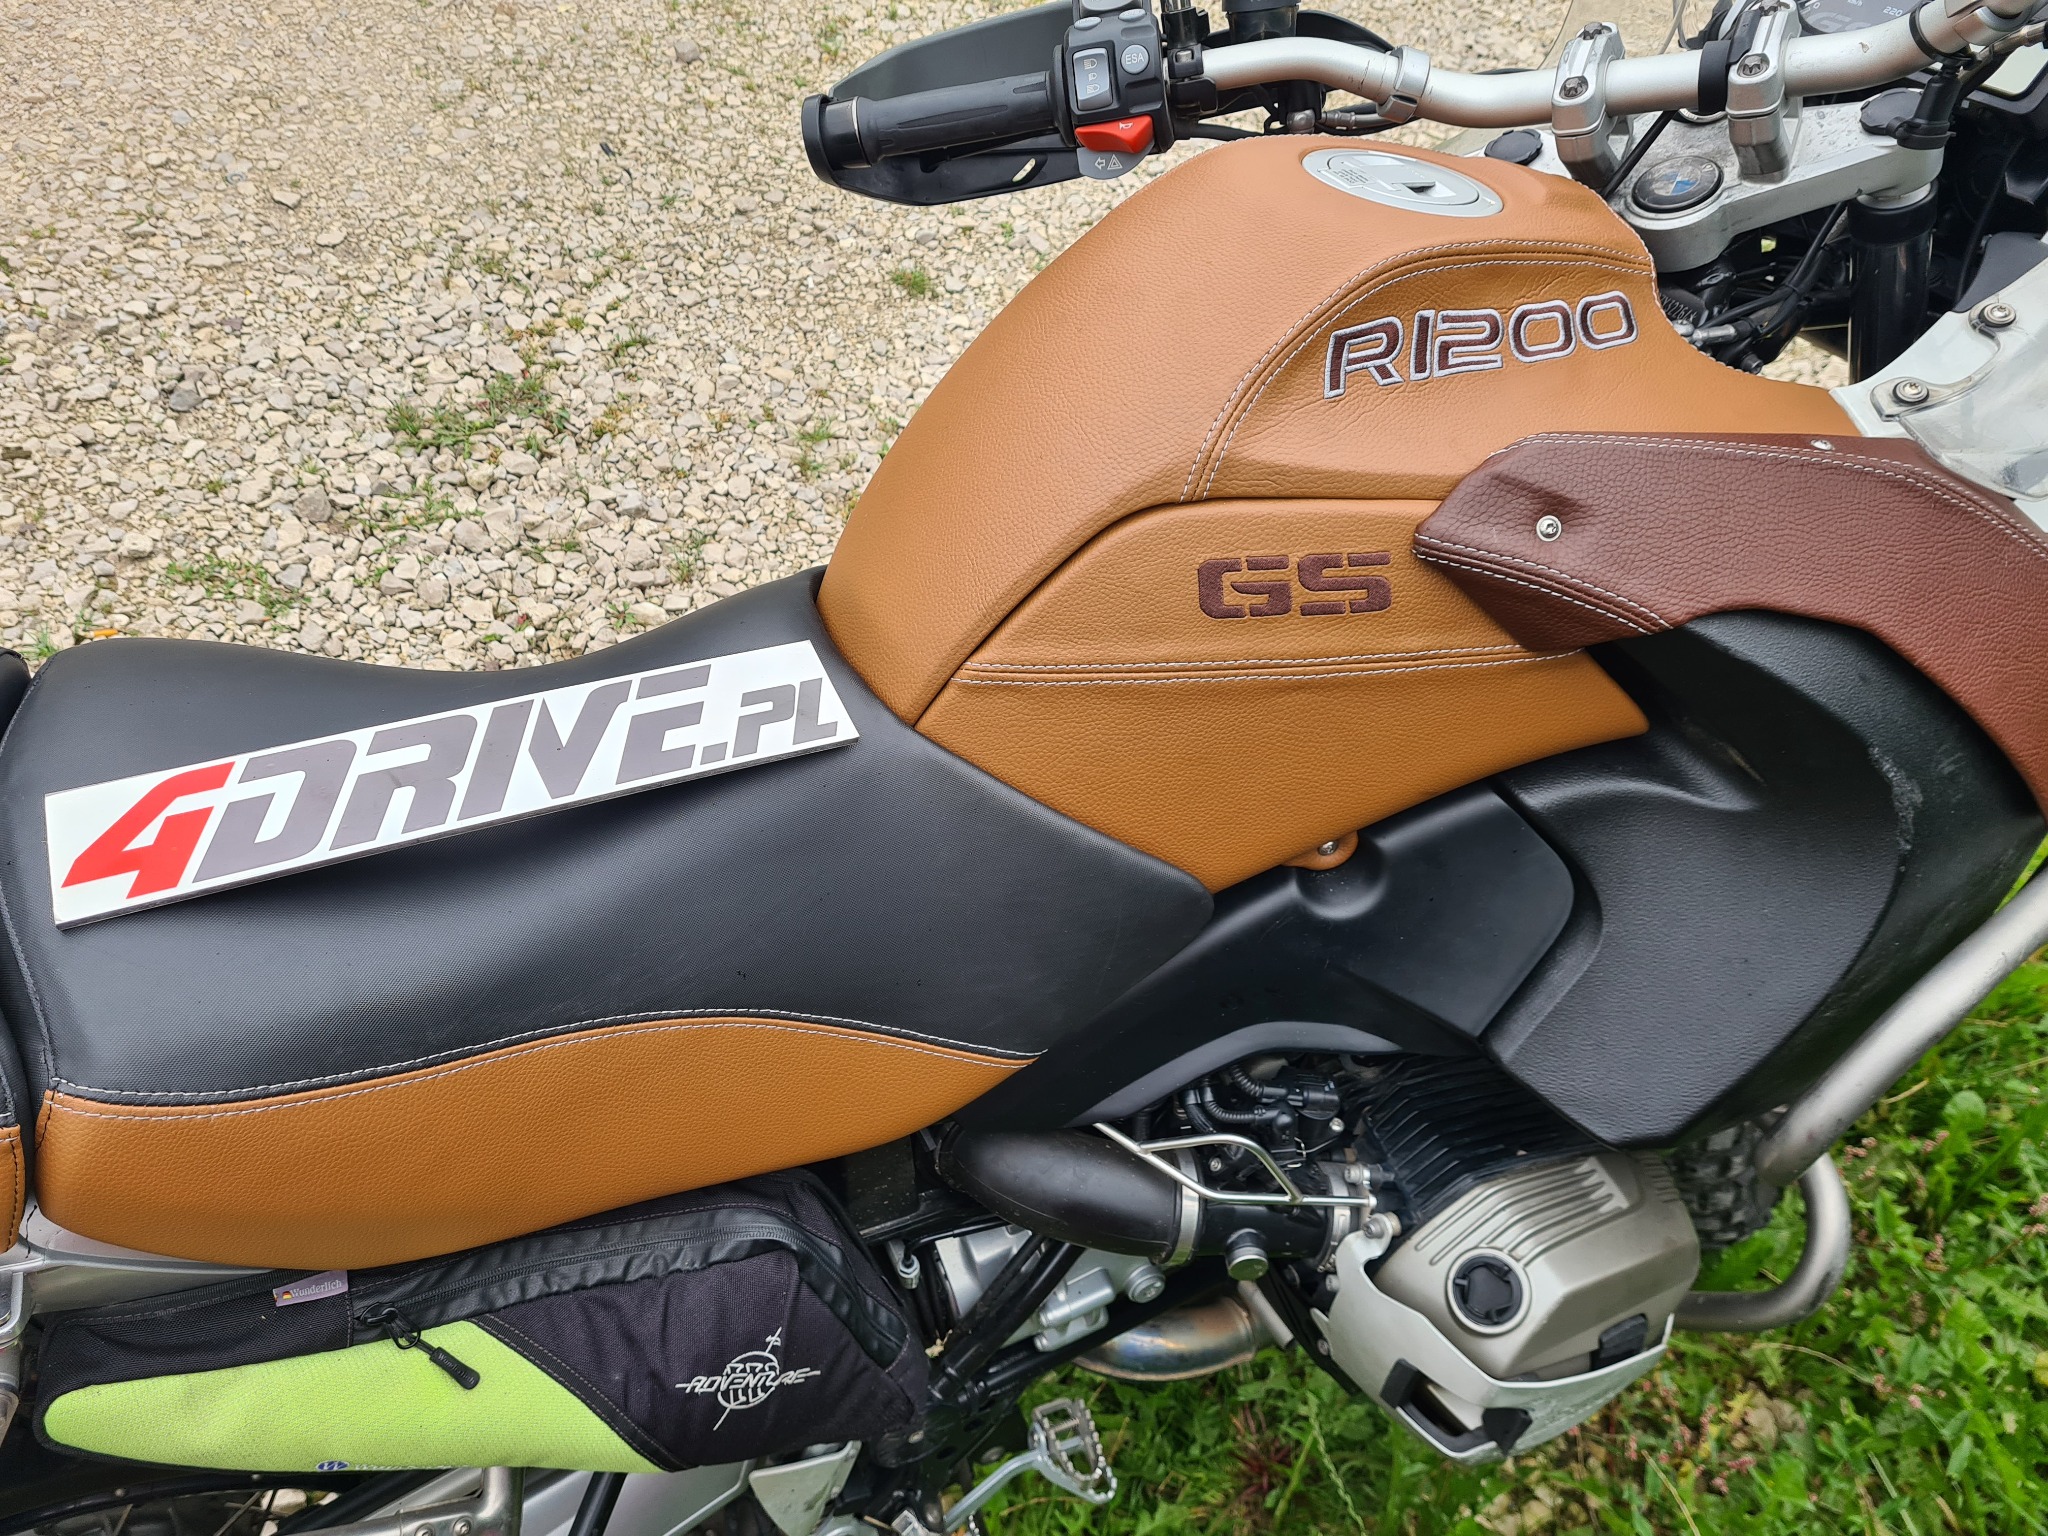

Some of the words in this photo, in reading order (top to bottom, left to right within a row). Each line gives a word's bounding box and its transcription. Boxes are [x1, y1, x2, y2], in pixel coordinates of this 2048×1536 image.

[1883, 6, 1903, 17] 220
[1125, 53, 1145, 65] ESA
[1323, 290, 1638, 399] R1200
[1198, 551, 1392, 619] GS
[61, 664, 838, 899] 4DRIVE.PL
[289, 1279, 342, 1299] Wunderlich
[675, 1366, 821, 1395] ADVENTURE
